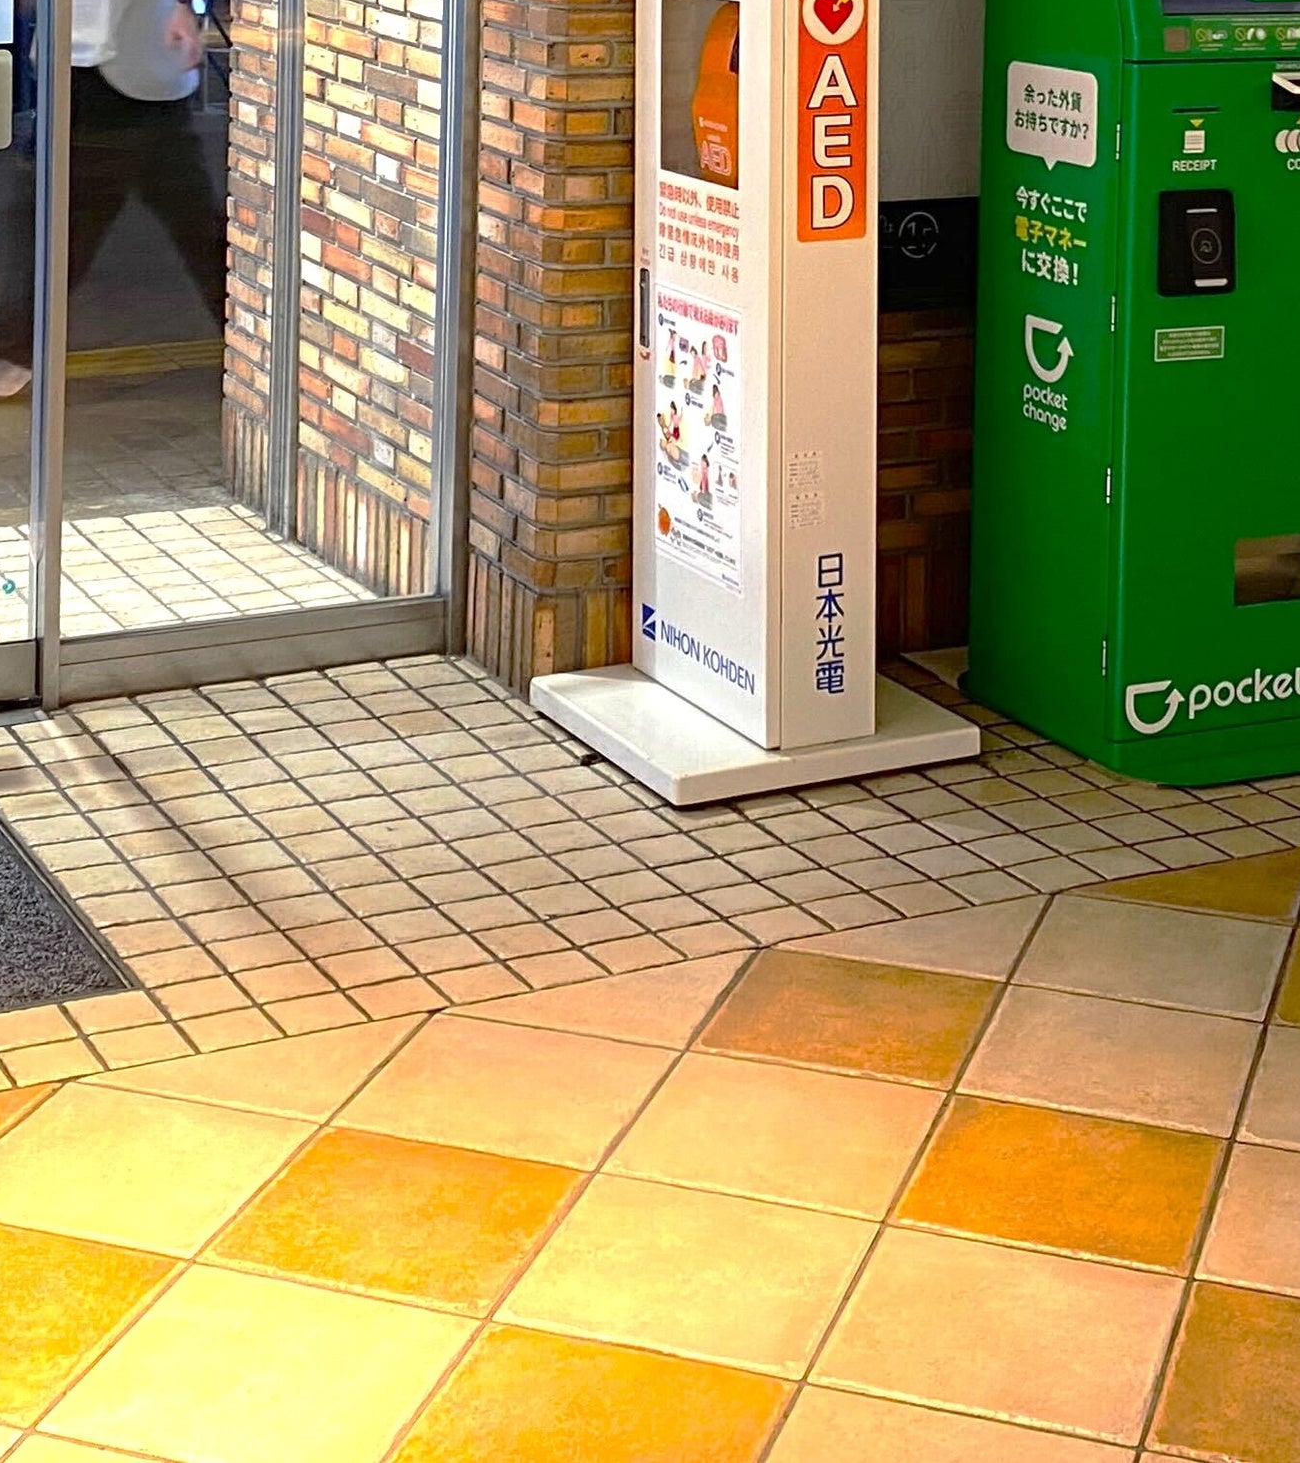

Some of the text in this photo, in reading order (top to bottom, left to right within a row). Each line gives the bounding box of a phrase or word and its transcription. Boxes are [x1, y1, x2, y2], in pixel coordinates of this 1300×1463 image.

[1023, 83, 1082, 113] 余った外貨
[700, 140, 732, 177] AED
[806, 53, 859, 230] AED
[1172, 158, 1218, 173] RECEIPT
[1015, 185, 1088, 223] 今すぐここで
[1015, 215, 1087, 251] 電子マネー
[721, 263, 739, 284] 사용
[1023, 383, 1069, 412] pocket
[1022, 401, 1068, 432] change
[814, 552, 846, 695] 日本光電
[660, 619, 756, 696] NIHON KOHDEN
